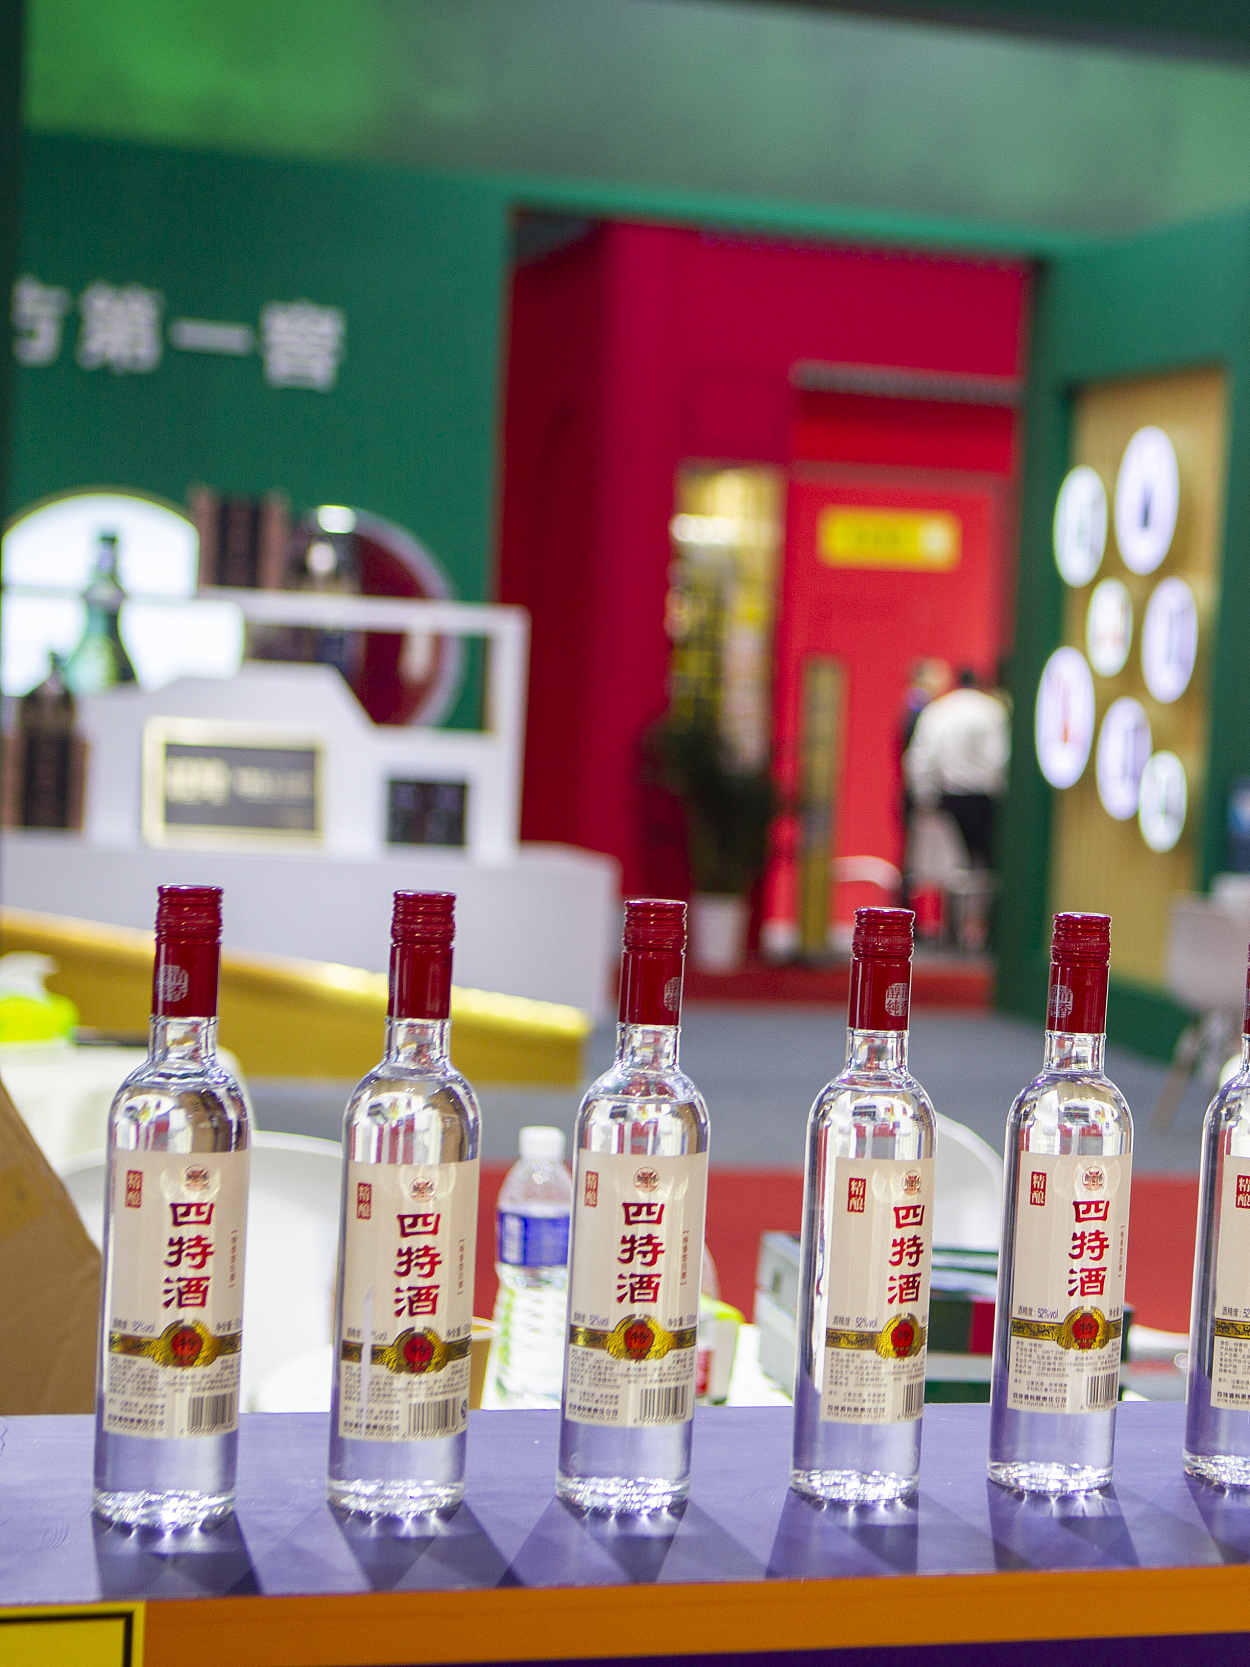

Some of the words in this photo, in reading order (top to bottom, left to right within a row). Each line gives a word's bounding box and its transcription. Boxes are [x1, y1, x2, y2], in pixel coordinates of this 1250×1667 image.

[847, 1178, 866, 1213] 精酿
[1030, 1171, 1047, 1206] 精酿
[164, 1203, 214, 1308] 四特酒
[394, 1213, 442, 1317] 四特酒
[617, 1202, 665, 1303] 四特酒
[888, 1204, 925, 1304] 四特酒
[1068, 1200, 1109, 1296] 四特酒
